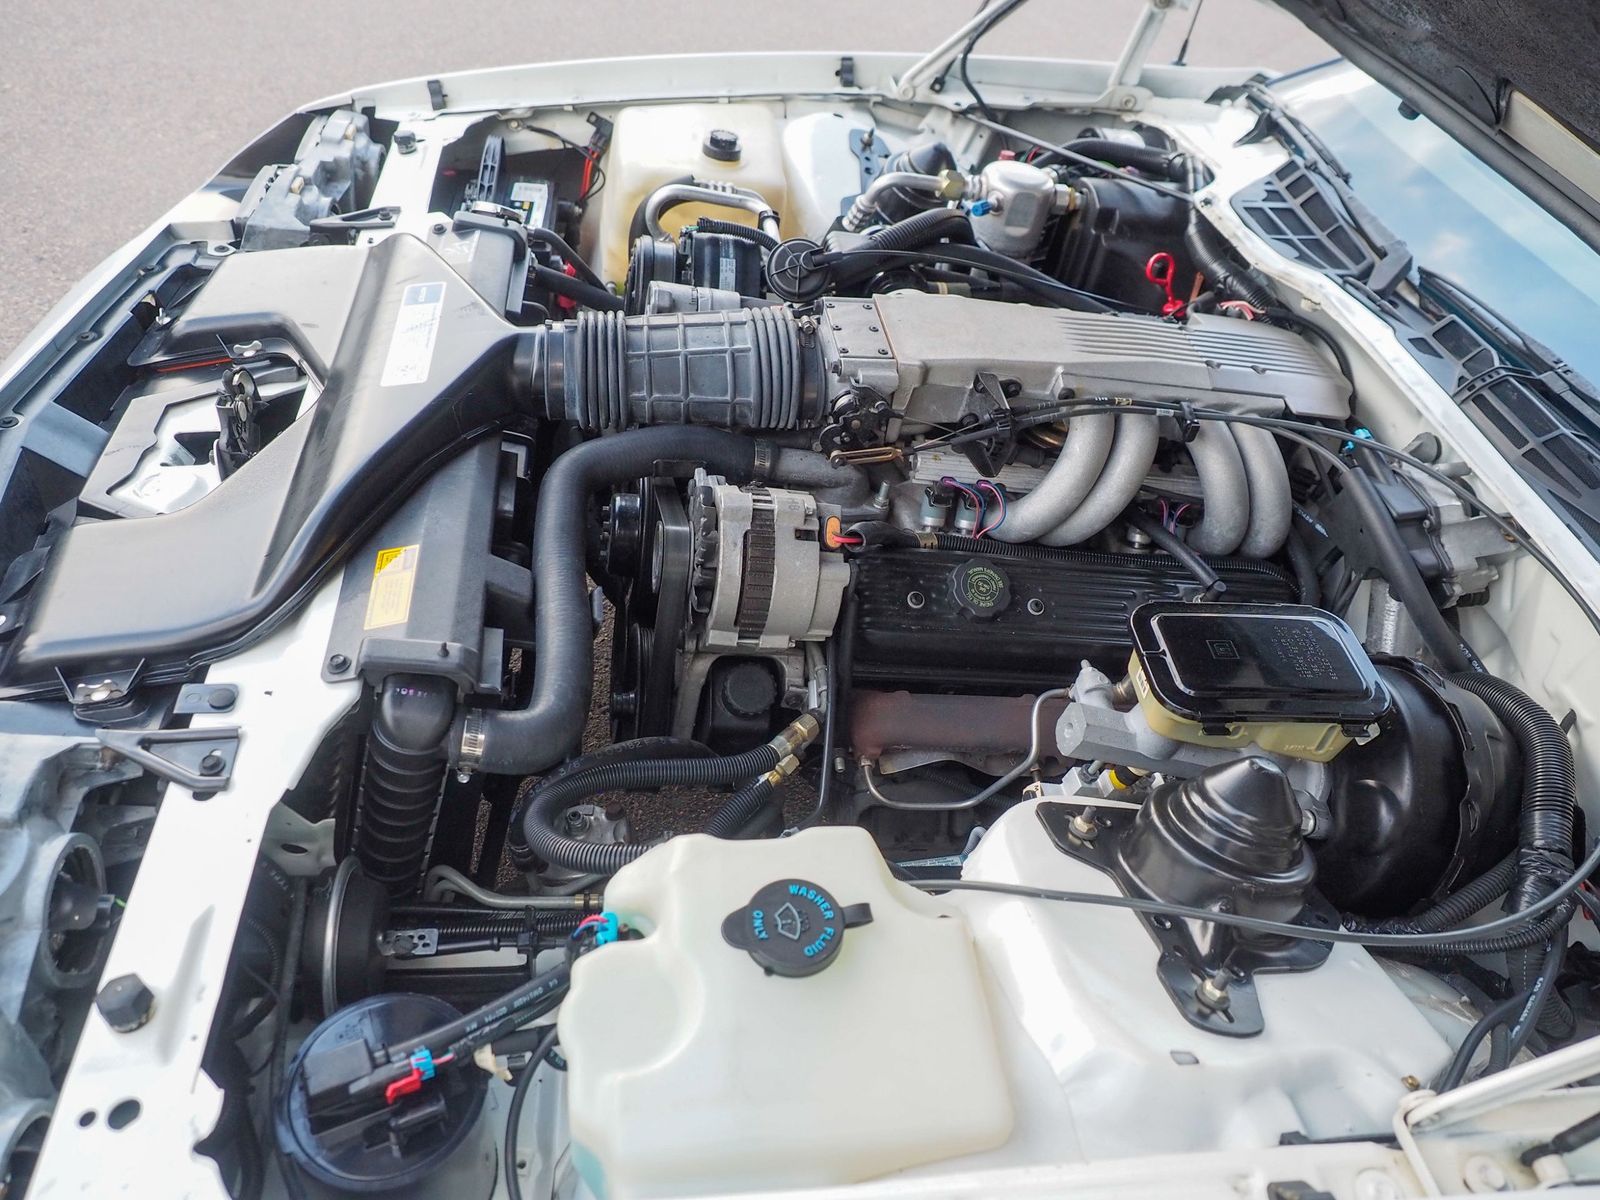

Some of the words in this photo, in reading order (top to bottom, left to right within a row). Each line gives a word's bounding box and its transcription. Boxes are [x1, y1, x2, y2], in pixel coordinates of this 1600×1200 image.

[788, 884, 834, 920] WASHER
[752, 909, 769, 940] ONLY
[803, 926, 835, 957] FLUID
